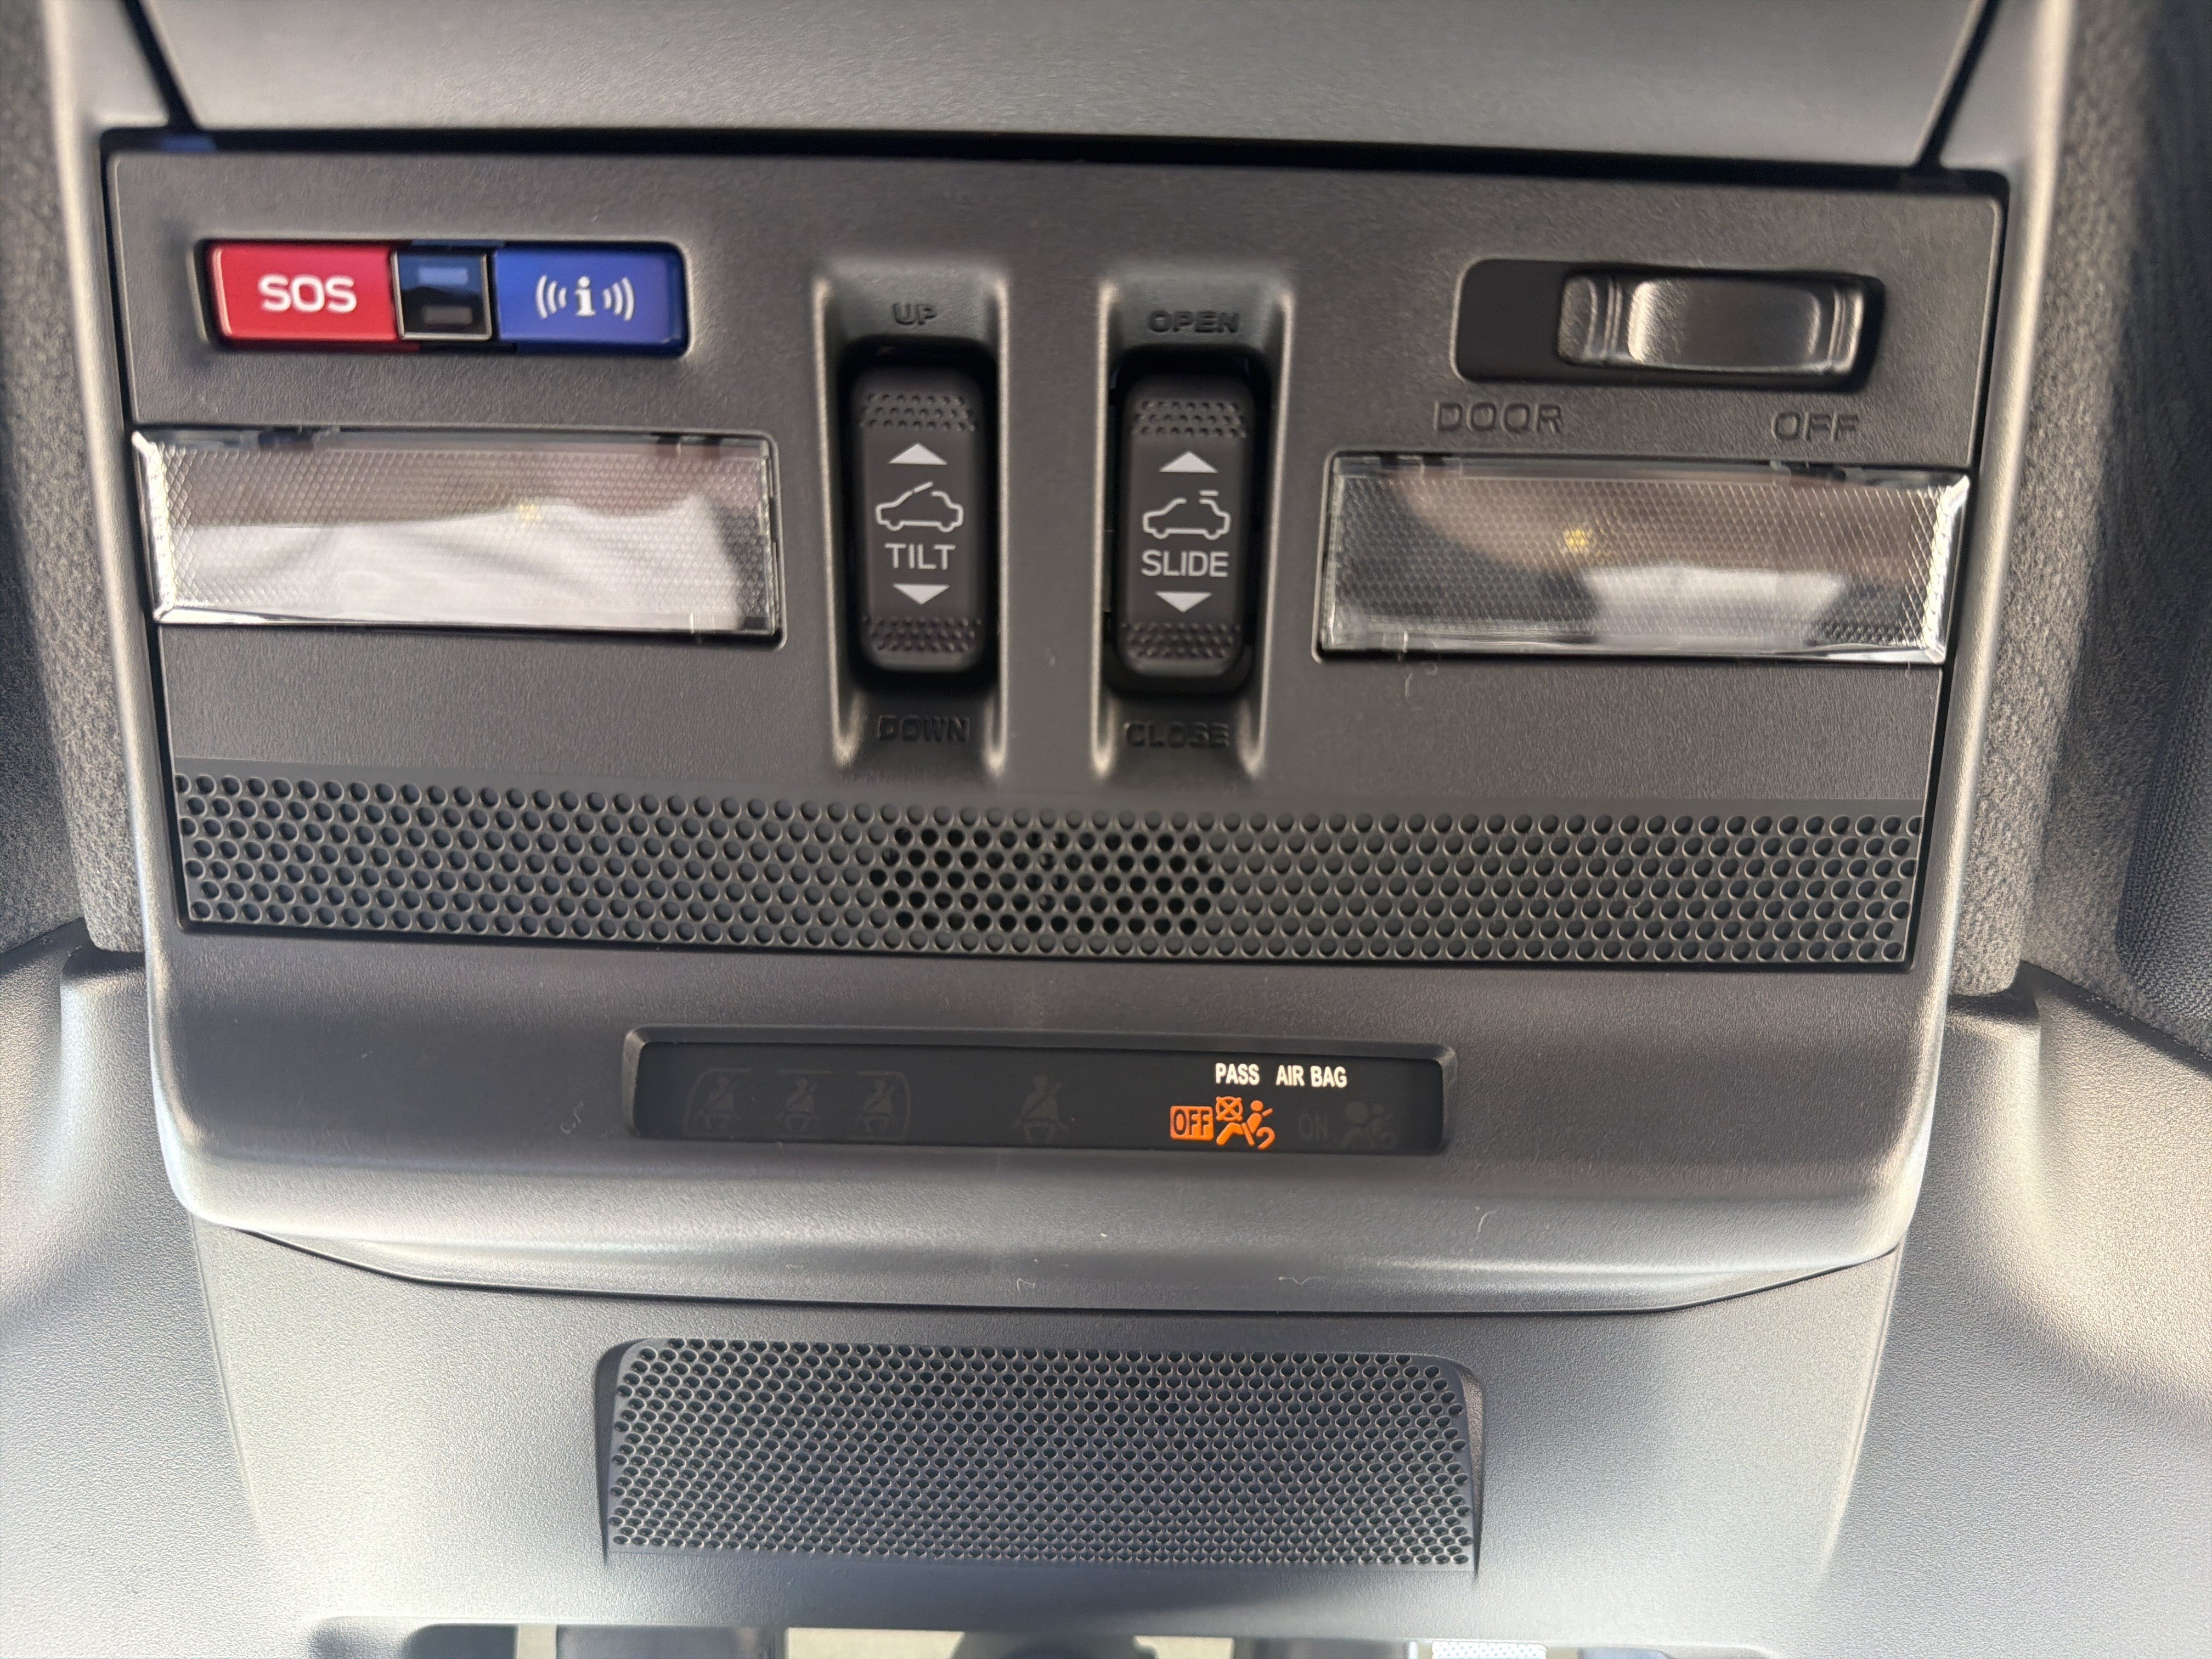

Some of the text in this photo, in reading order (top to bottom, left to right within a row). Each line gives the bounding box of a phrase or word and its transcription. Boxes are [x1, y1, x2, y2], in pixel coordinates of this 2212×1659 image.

[258, 273, 358, 313] SOS
[891, 302, 938, 325] UP
[1148, 309, 1241, 334] OPEN
[1433, 402, 1565, 434] DOOR
[1770, 410, 1859, 441] OFF
[885, 543, 956, 569] TILT
[1141, 550, 1229, 578] SLIDE
[878, 715, 970, 743] DOWN
[1124, 720, 1230, 748] CLOSE
[1215, 1063, 1347, 1088] PASS AIR BAG
[1173, 1109, 1211, 1136] OFF
[1299, 1111, 1328, 1139] ON
